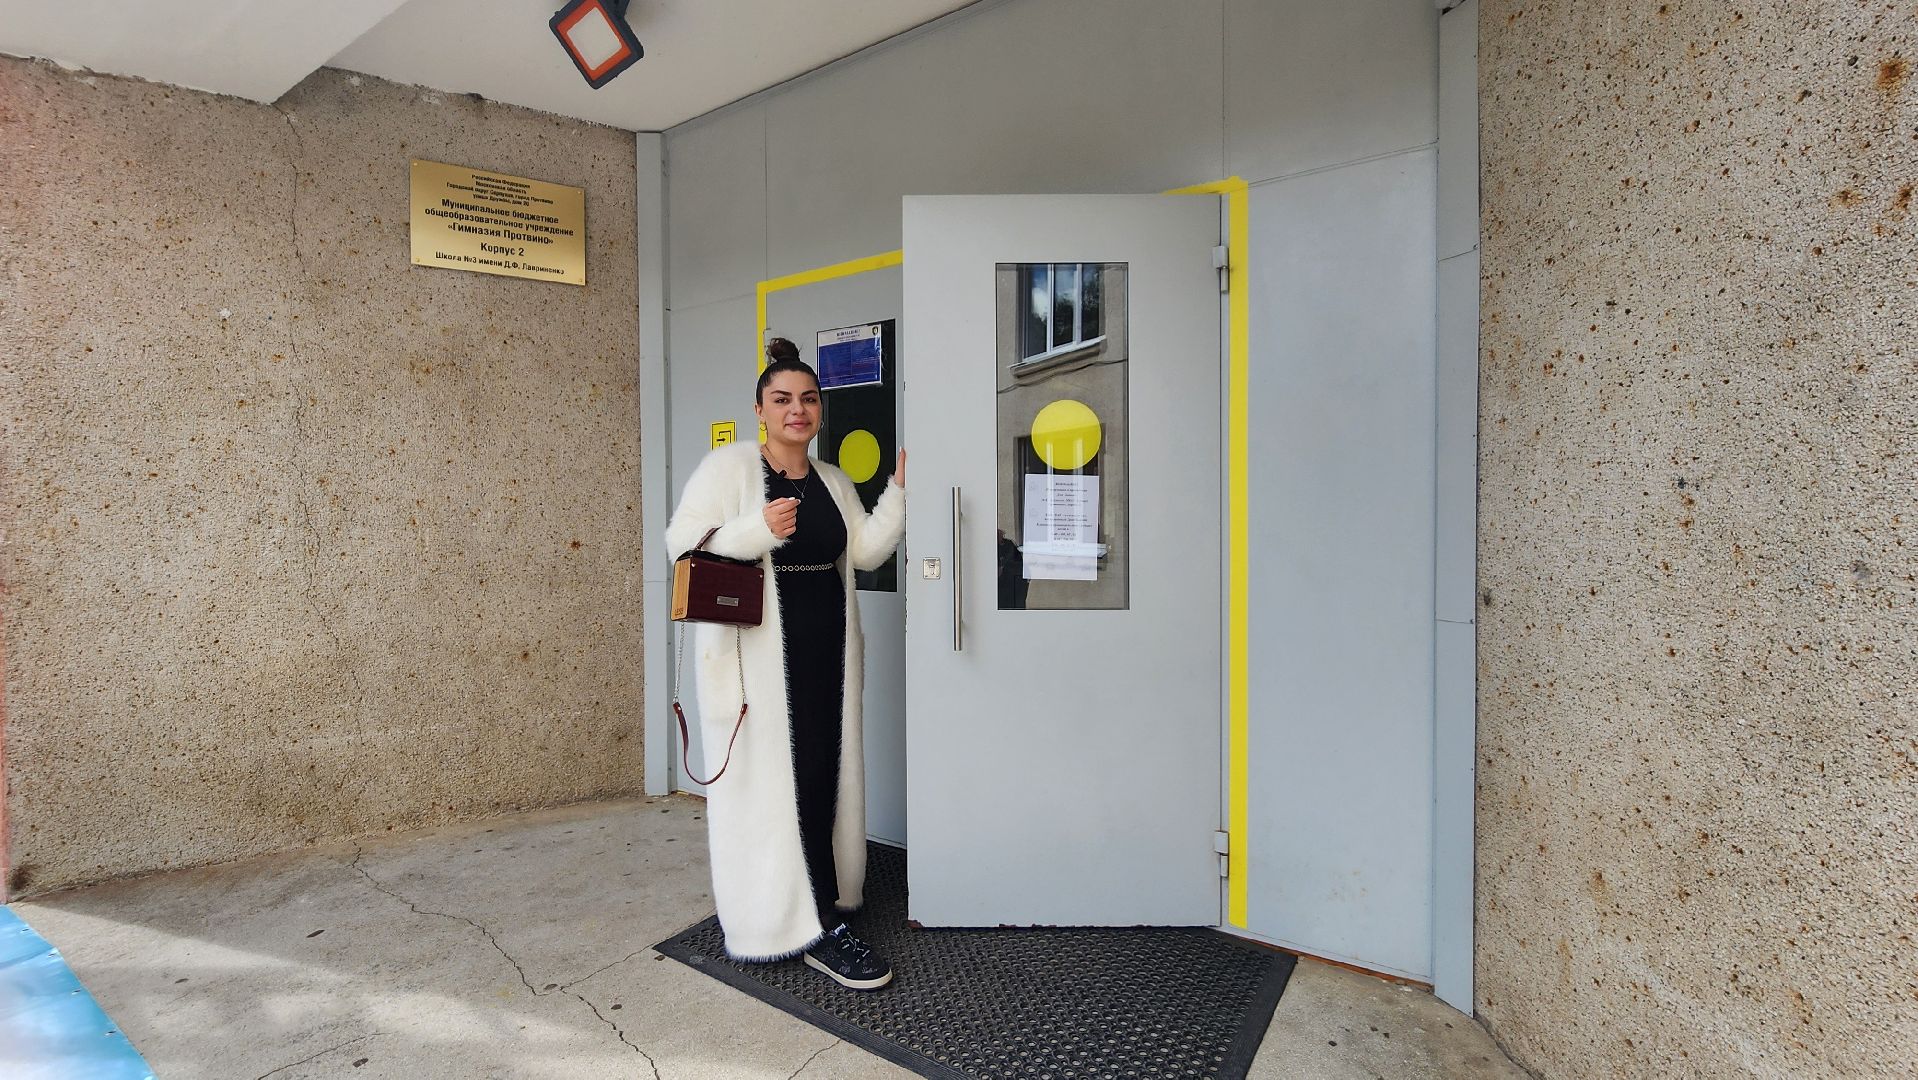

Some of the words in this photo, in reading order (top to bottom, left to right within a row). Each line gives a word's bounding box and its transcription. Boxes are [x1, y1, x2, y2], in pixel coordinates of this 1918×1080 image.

[424, 207, 523, 229] общеобразовательное
[525, 222, 574, 236] учреждение
[441, 198, 510, 216] Муниципальное
[512, 209, 559, 224] бюджетное
[448, 222, 501, 237] «Гимназия
[503, 229, 554, 245] Протвино»
[435, 251, 462, 262] Школа
[463, 255, 477, 263] №3
[478, 258, 503, 267] имени
[480, 242, 516, 256] Корпус
[518, 247, 525, 256] 2
